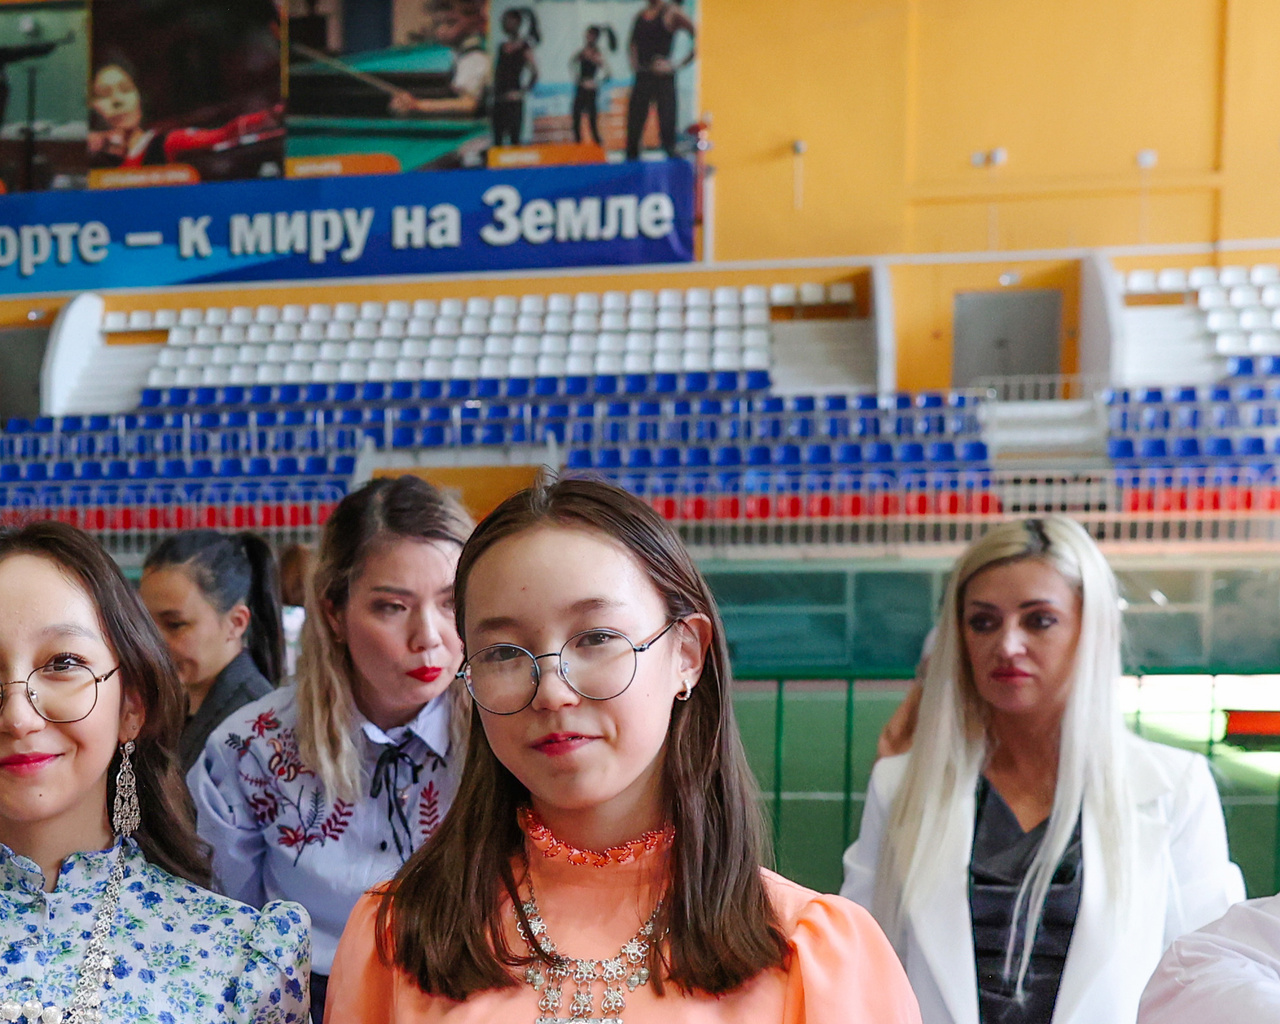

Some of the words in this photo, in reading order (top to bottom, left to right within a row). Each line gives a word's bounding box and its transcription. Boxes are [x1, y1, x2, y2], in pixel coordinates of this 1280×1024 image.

[179, 215, 213, 258] к
[229, 207, 375, 264] миру
[392, 203, 462, 249] на
[480, 185, 674, 246] Земле
